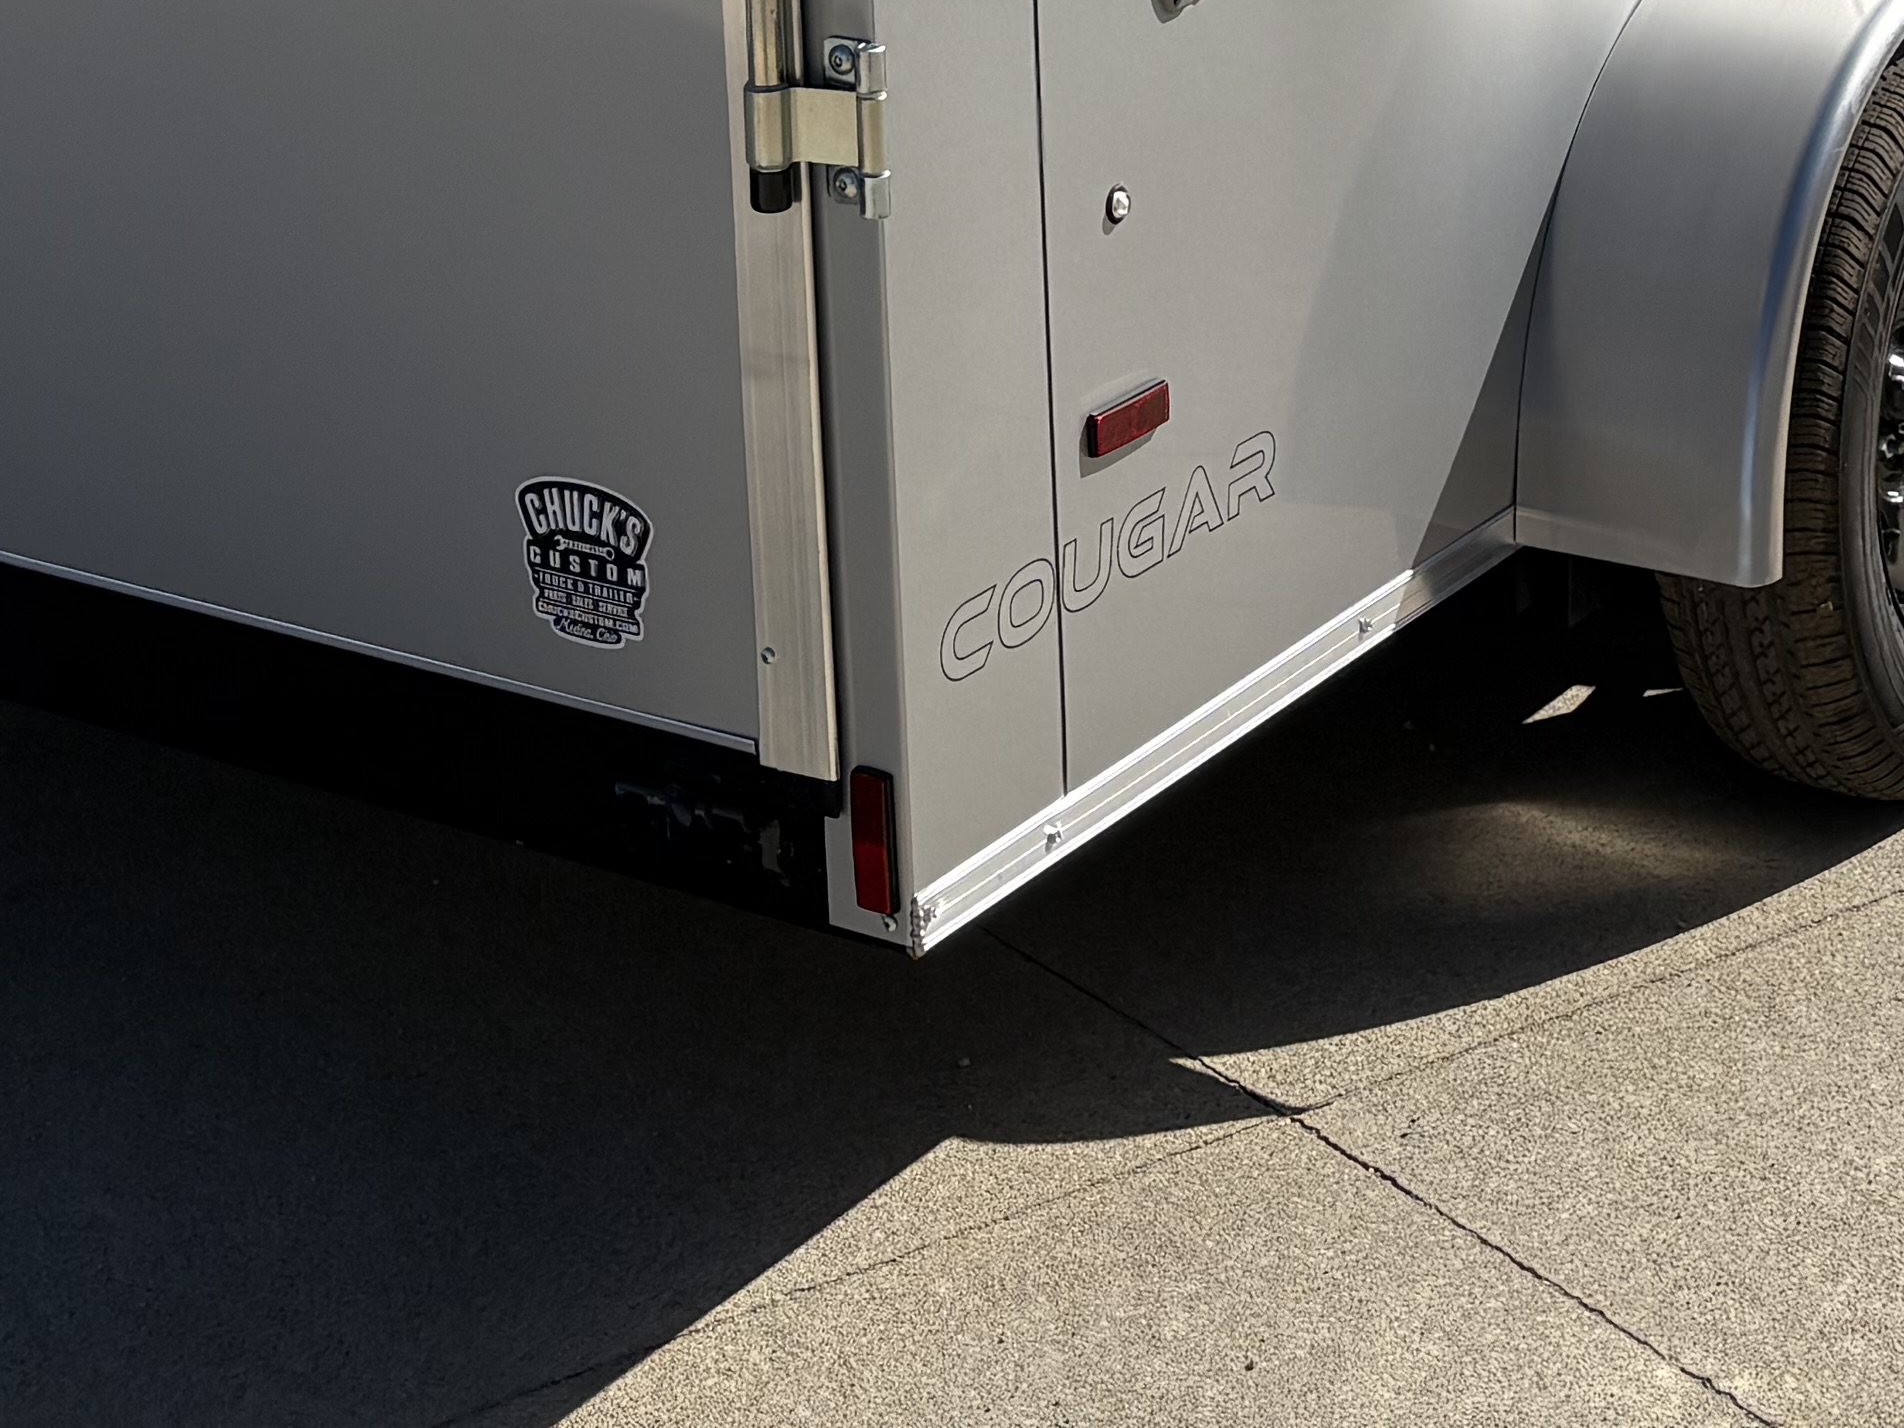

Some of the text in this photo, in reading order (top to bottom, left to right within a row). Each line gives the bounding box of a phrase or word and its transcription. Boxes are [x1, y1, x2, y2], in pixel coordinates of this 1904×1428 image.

[524, 487, 643, 557] CHUCK'S
[939, 430, 1277, 682] COUGAR
[529, 546, 643, 587] CUSTOM
